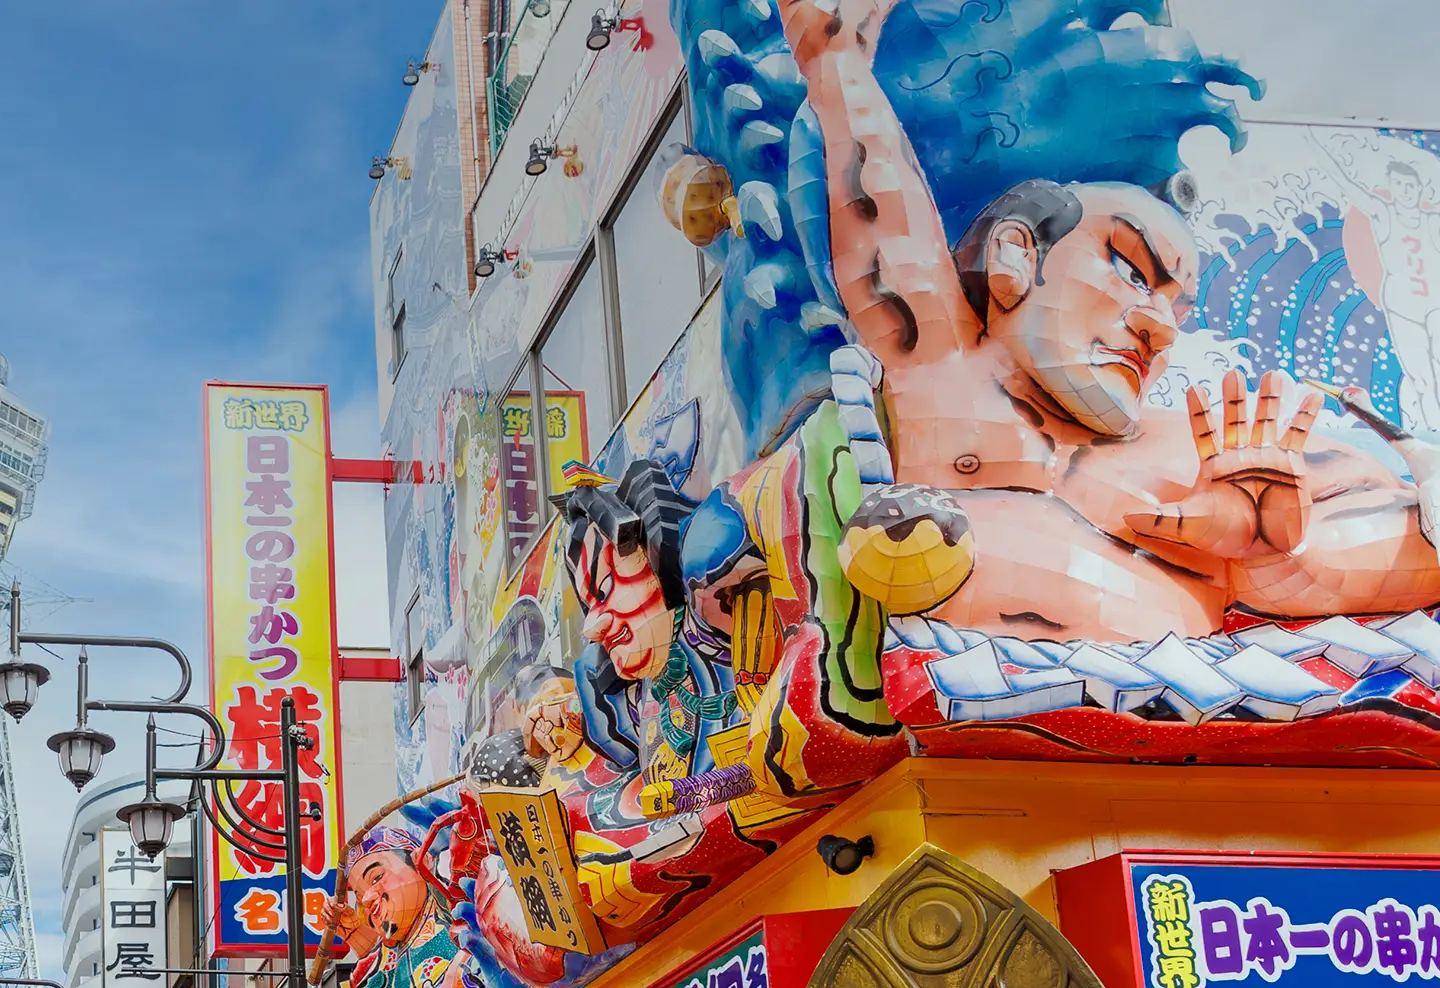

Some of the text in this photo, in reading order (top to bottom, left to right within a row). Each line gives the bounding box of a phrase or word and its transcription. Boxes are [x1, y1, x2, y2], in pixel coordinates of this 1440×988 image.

[224, 399, 308, 431] 新世界
[244, 435, 299, 681] 日本一の串かつ
[227, 685, 324, 876] 横綱
[496, 811, 557, 932] 横綱
[526, 804, 577, 946] 日本一の串かつ
